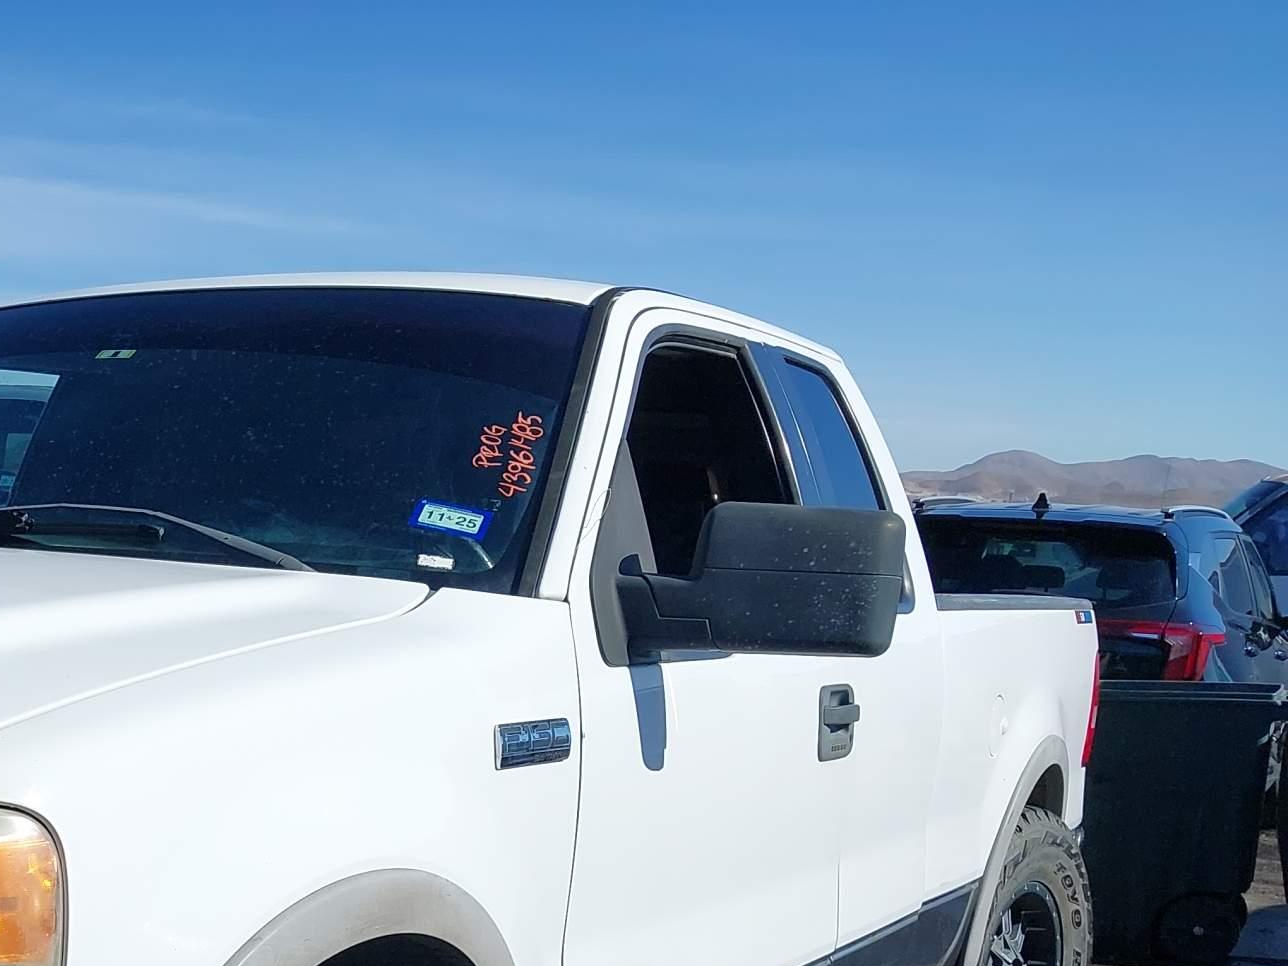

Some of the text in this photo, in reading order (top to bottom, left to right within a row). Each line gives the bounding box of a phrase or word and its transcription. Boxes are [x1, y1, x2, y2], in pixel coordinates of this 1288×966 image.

[472, 424, 508, 468] PROG
[498, 411, 544, 498] 43961485
[426, 510, 479, 529] 11 25
[1055, 861, 1082, 930] TOYO
